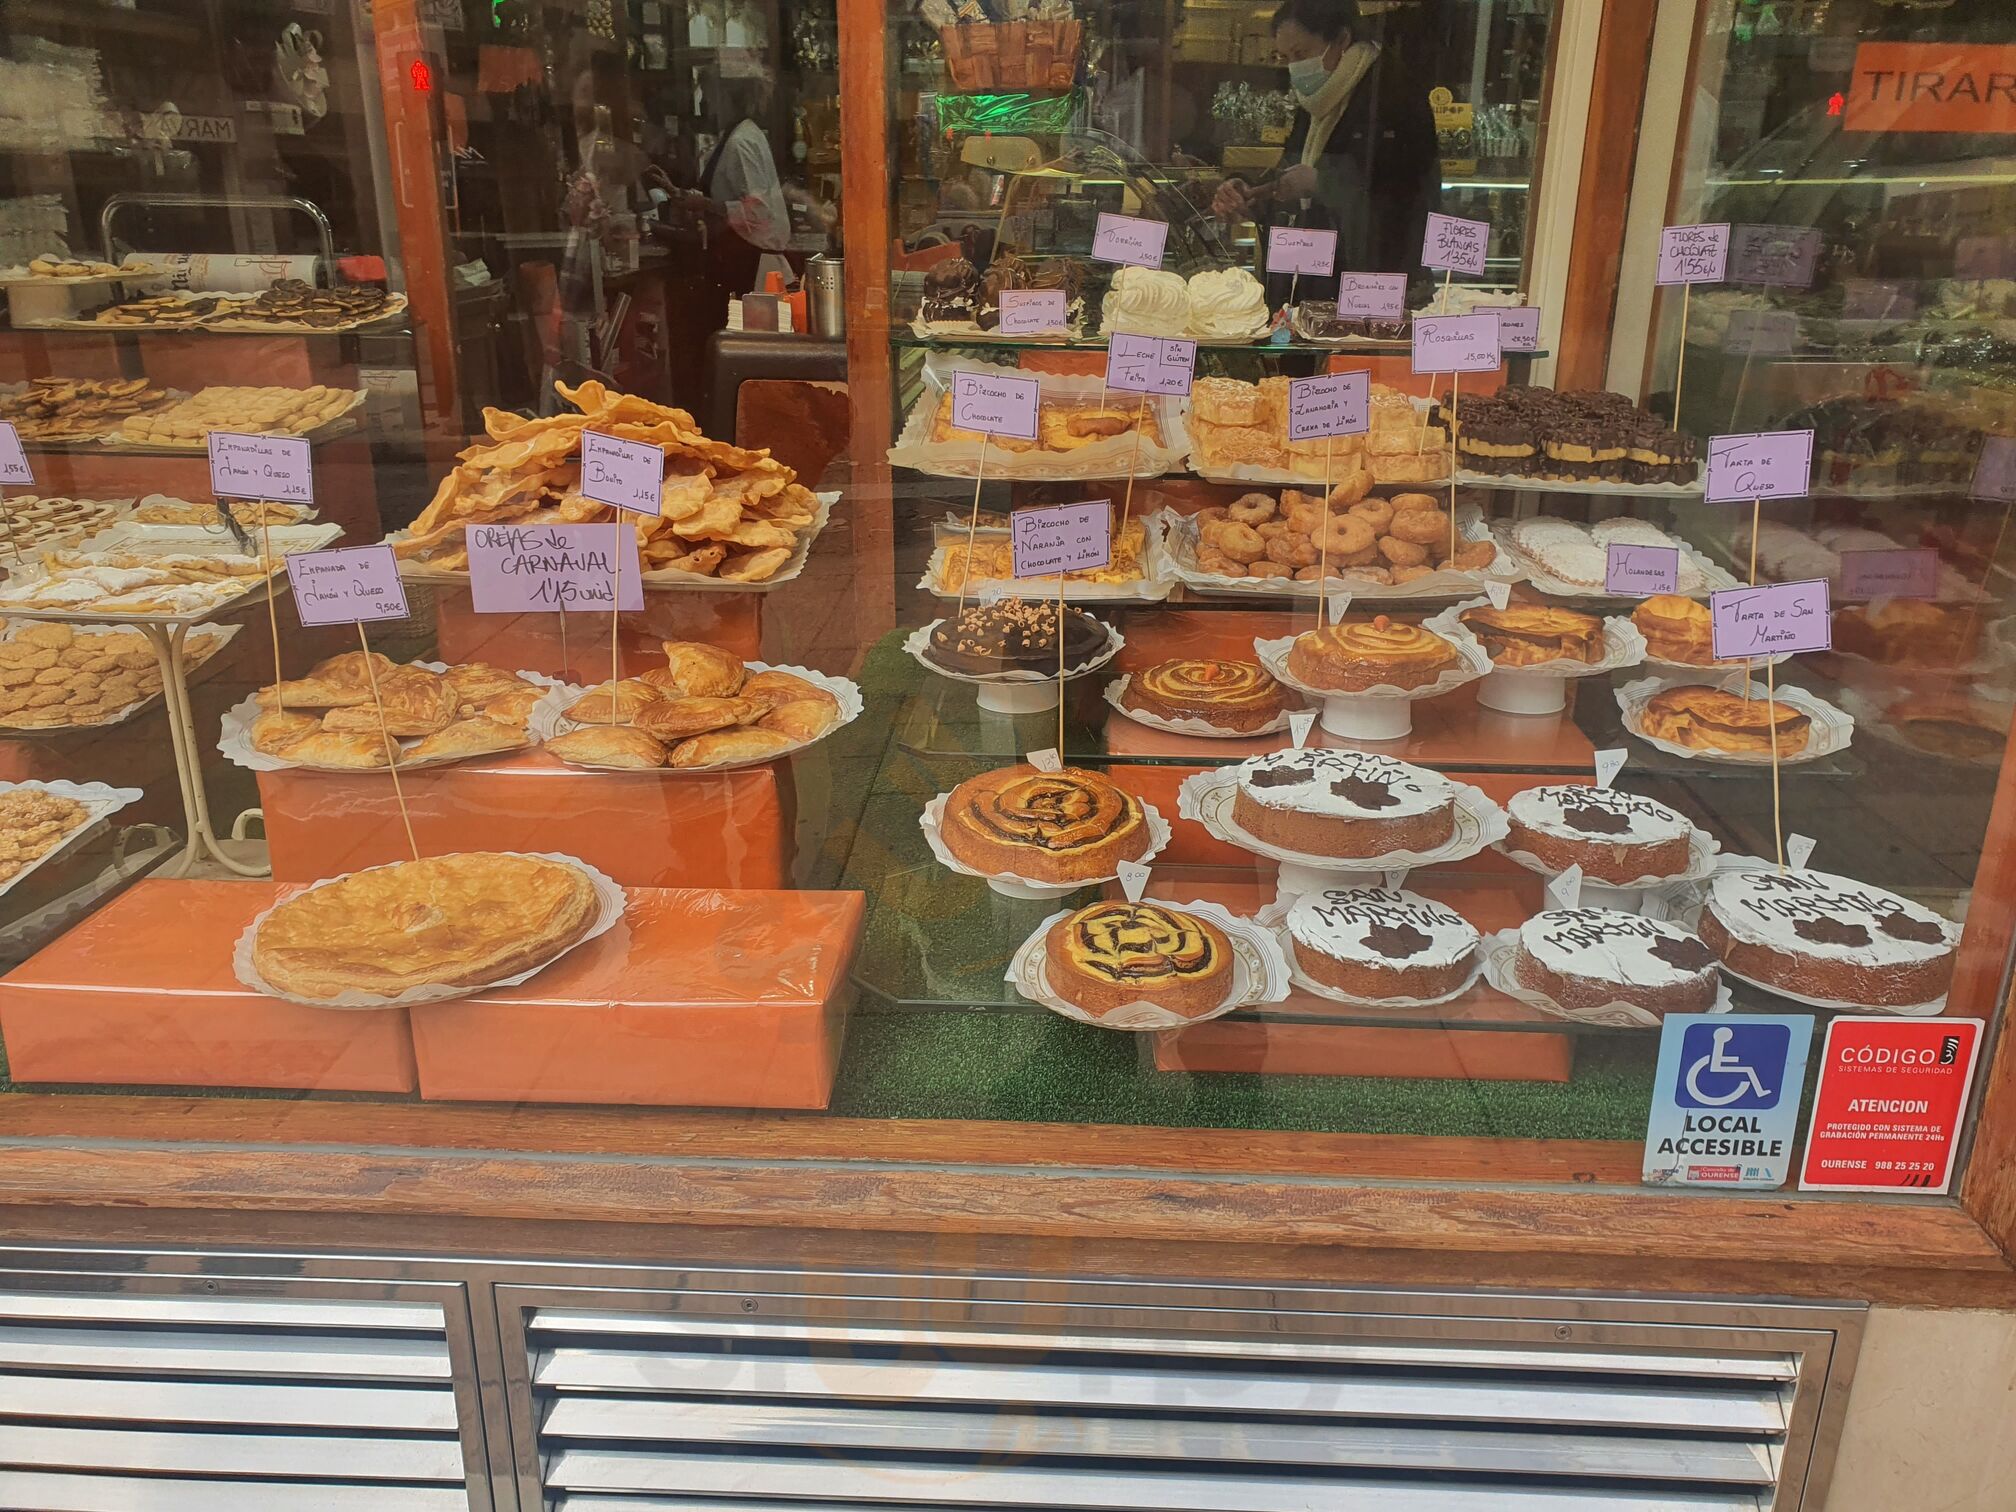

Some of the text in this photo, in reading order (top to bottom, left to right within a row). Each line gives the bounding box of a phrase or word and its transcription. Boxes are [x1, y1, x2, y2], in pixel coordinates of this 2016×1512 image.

[1863, 71, 2016, 104] TIRAR
[1840, 1044, 1936, 1065] CÓDIGO
[1838, 1065, 1953, 1075] SISTEMAS DE SEGURIDAD
[1847, 1098, 1929, 1114] ATENCION
[1685, 1115, 1762, 1134] LOCAL
[1826, 1122, 1941, 1133] PROTEGIDO CON SISTEMA DE
[1819, 1131, 1868, 1140] GRABACIÓN
[1868, 1132, 1924, 1141] PERMANENTE
[1657, 1138, 1783, 1157] ACCESIBLE
[1821, 1159, 1935, 1172] OURENSE 988 25 25 20
